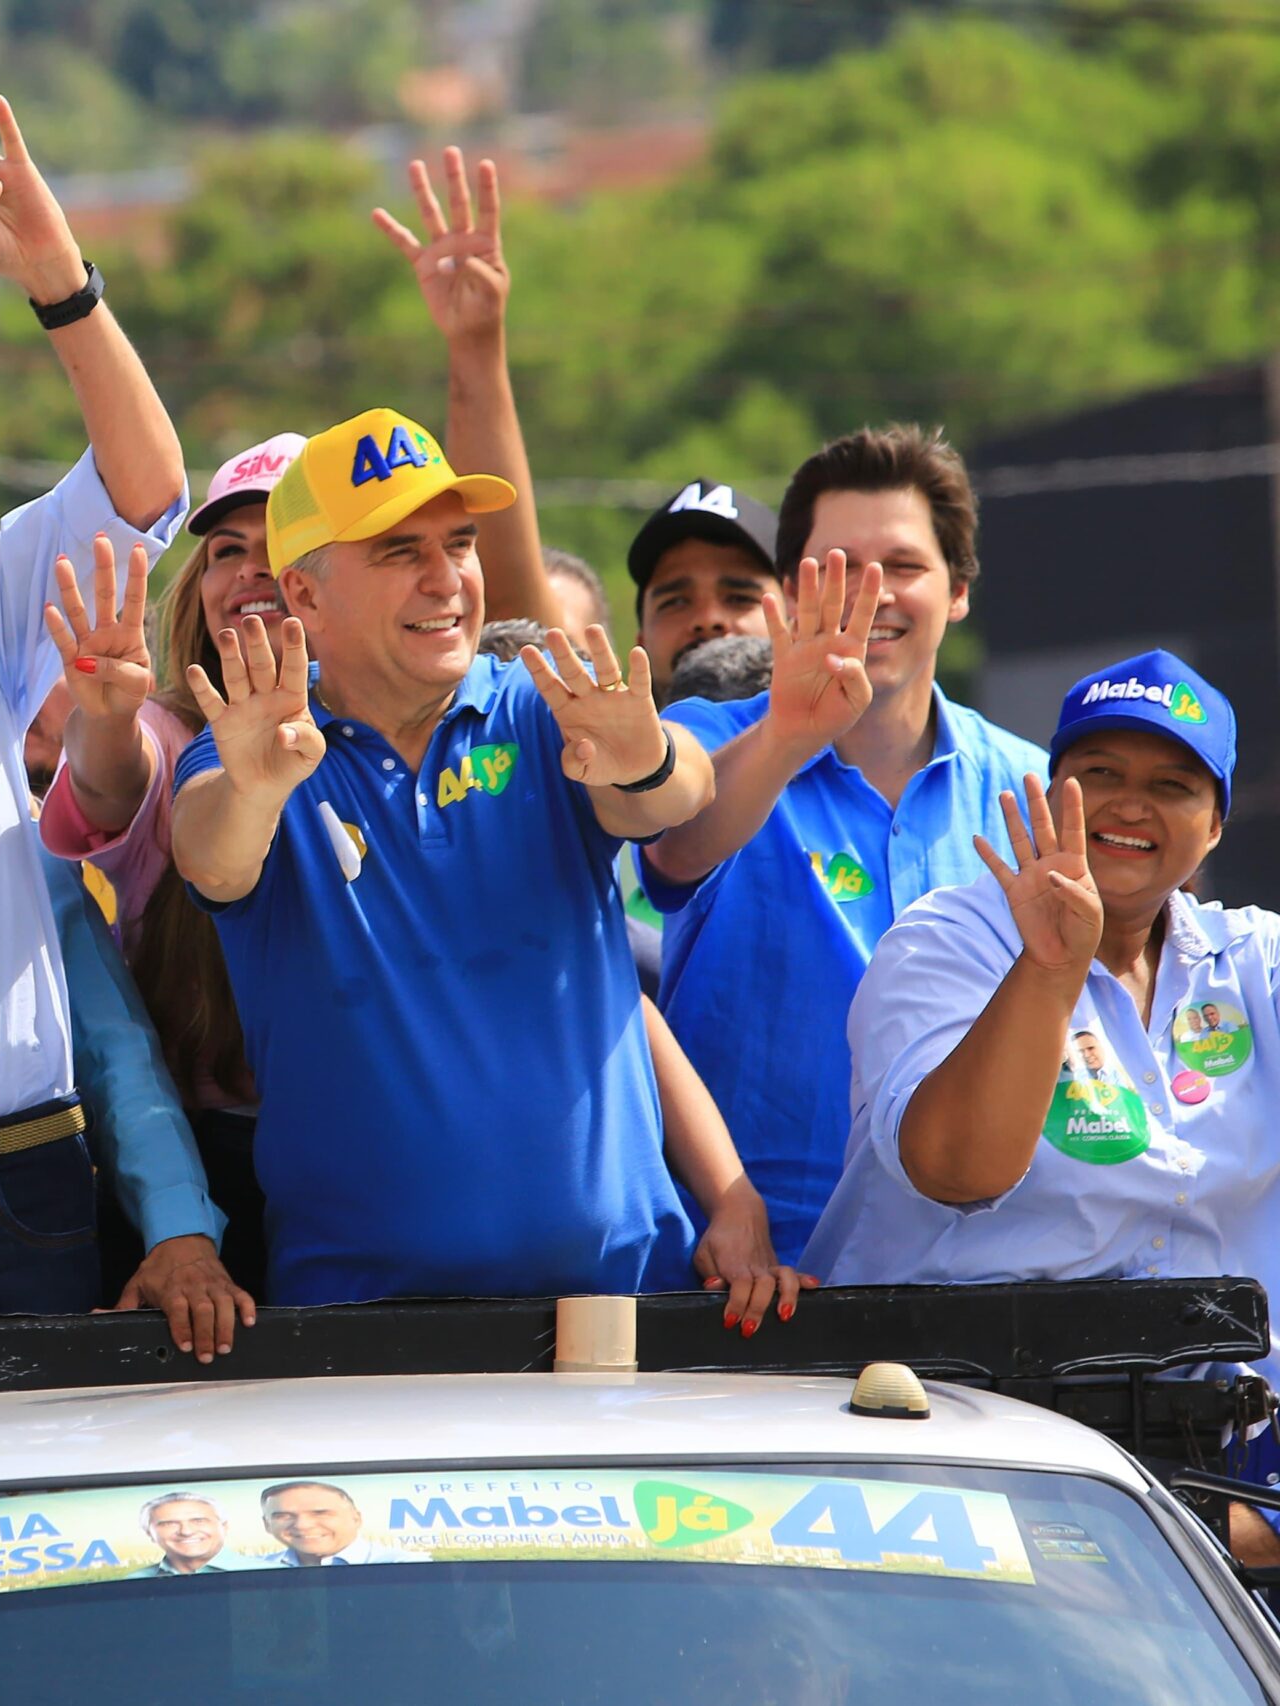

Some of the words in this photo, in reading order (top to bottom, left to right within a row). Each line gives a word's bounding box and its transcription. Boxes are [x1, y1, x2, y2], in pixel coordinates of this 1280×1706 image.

[351, 426, 427, 487] 44
[1081, 677, 1174, 707] Mabel
[481, 748, 512, 790] Já
[830, 867, 863, 894] Já
[1066, 1116, 1132, 1135] Mabel
[415, 1480, 593, 1494] PREFEITO
[389, 1496, 631, 1530] Mabel
[647, 1496, 729, 1543] Já
[770, 1483, 999, 1572] 44
[455, 1533, 542, 1545] CORONEL
[547, 1531, 631, 1545] CLÁUDIA
